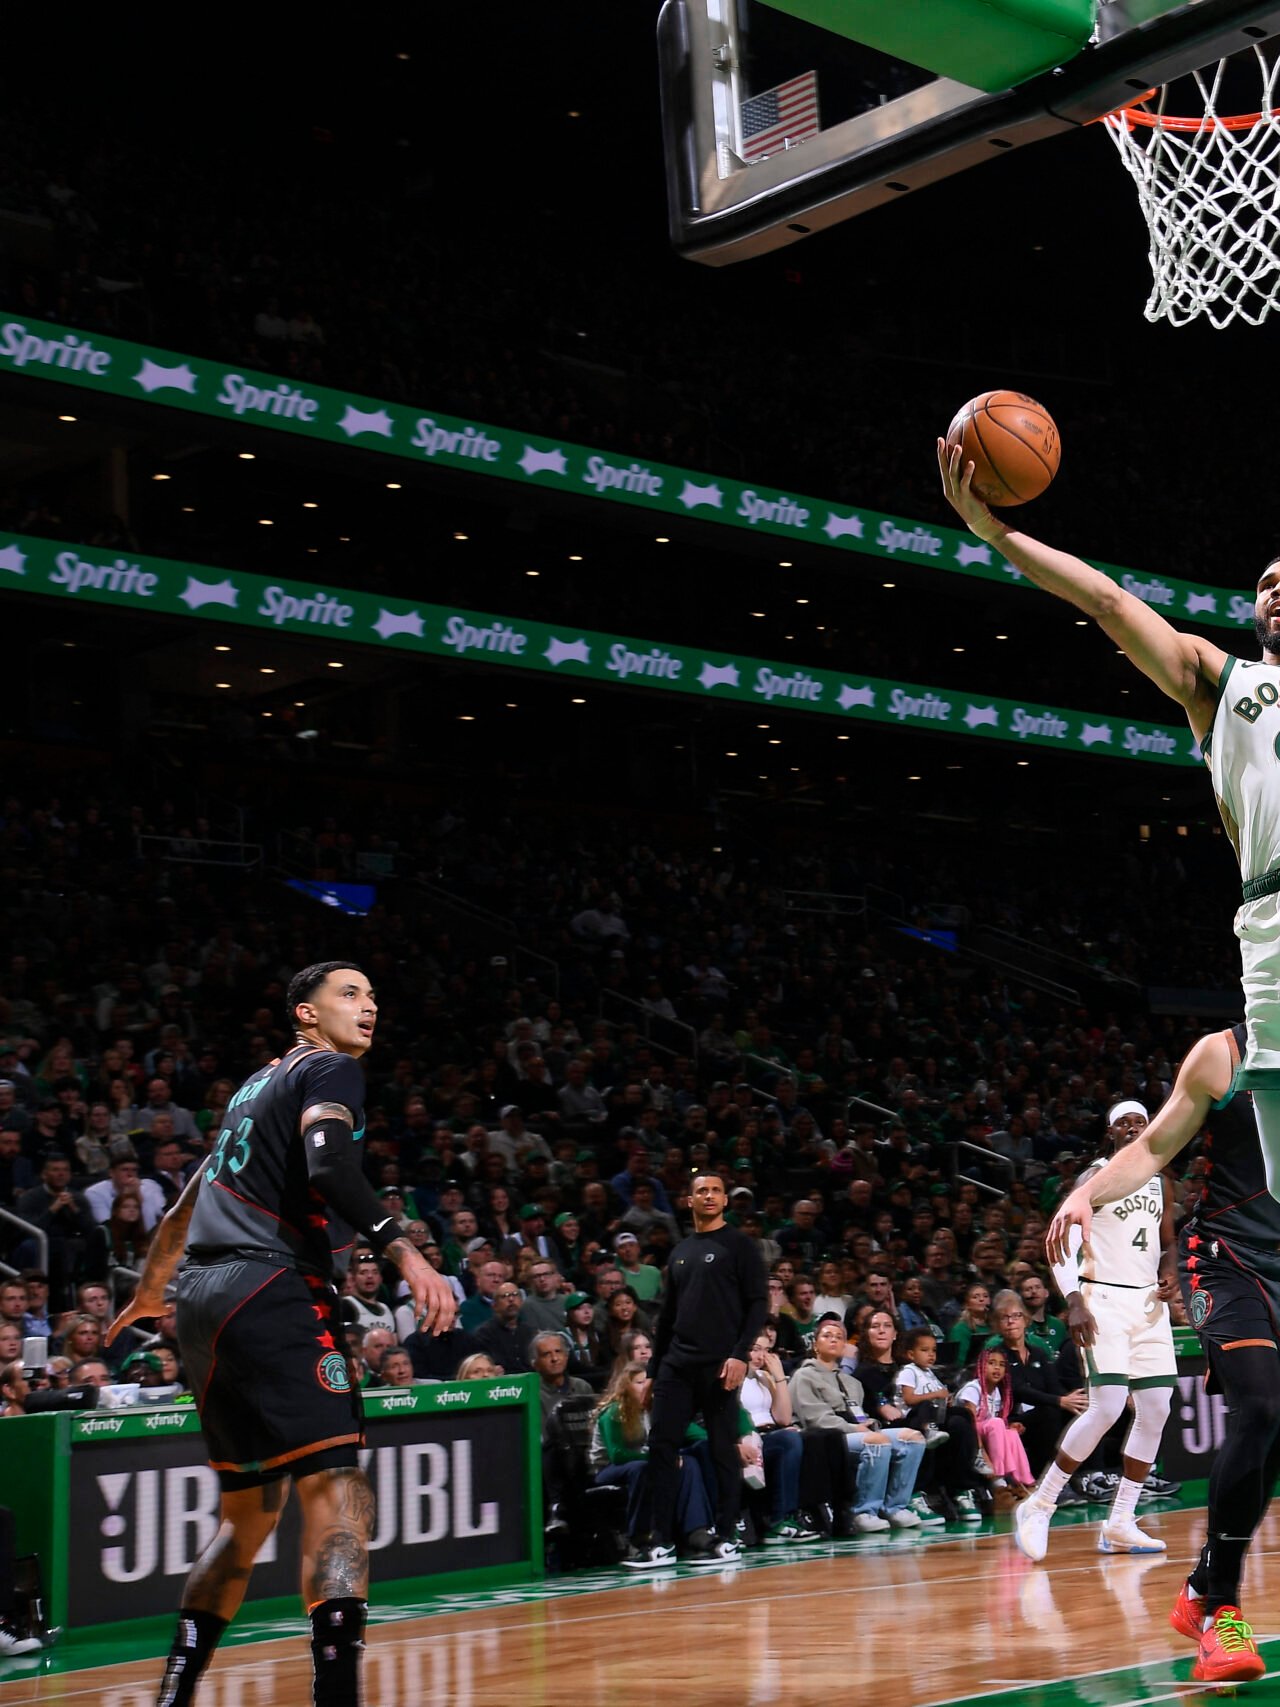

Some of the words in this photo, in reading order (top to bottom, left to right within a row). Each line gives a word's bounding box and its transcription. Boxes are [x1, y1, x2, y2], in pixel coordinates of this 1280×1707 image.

[0, 322, 112, 377] Sprite
[217, 373, 319, 422] Sprite
[411, 416, 501, 462] Sprite
[582, 455, 664, 497] Sprite
[737, 489, 810, 528] Sprite
[876, 520, 943, 556] Sprite
[49, 551, 159, 597] Sprite
[1121, 573, 1175, 607] Sprite
[258, 586, 354, 627] Sprite
[442, 616, 527, 655] Sprite
[606, 643, 683, 680] Sprite
[753, 667, 824, 702] Sprite
[887, 688, 952, 721] Sprite
[1009, 708, 1069, 739] Sprite
[1122, 726, 1177, 756] Sprite
[205, 1117, 254, 1183] 33
[1131, 1227, 1149, 1252] 4
[382, 1395, 419, 1410] xfinity
[436, 1390, 472, 1406] xfinity
[488, 1385, 523, 1401] xfinity
[81, 1417, 125, 1435] xfinity
[145, 1412, 188, 1429] xfinity
[359, 1439, 500, 1551] JBL
